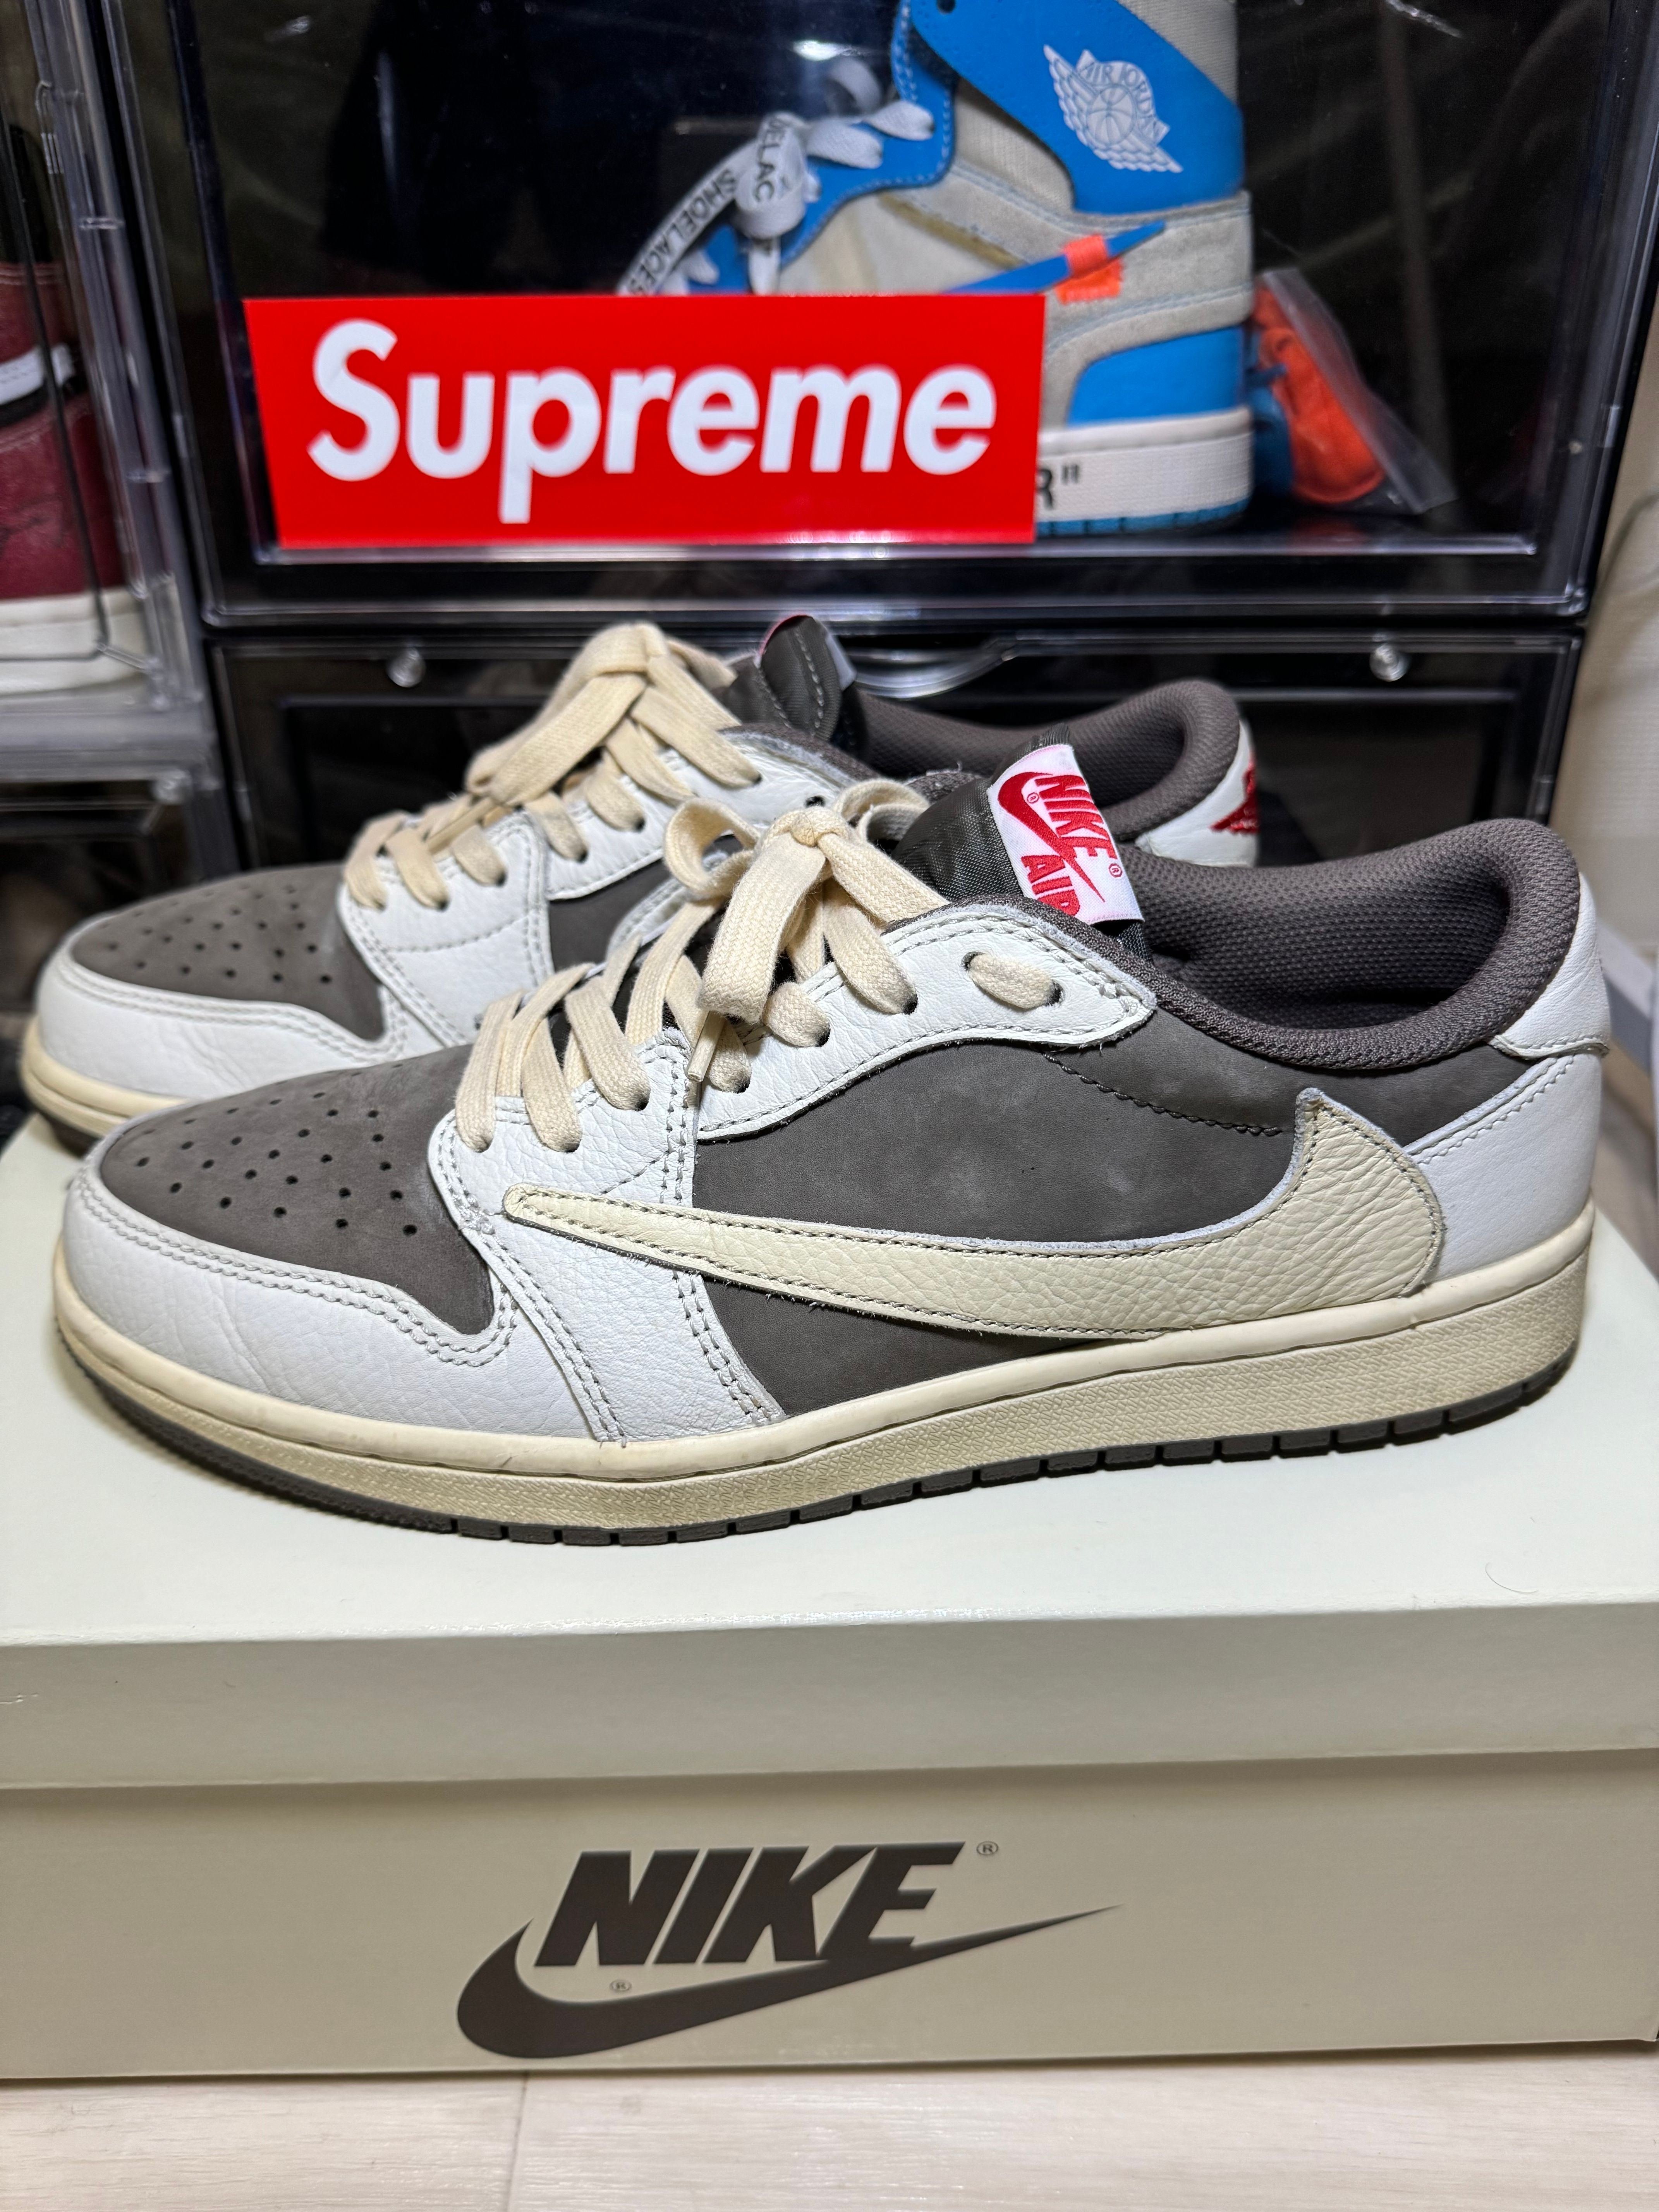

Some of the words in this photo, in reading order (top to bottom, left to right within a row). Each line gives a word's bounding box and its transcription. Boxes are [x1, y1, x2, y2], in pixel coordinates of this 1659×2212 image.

[307, 318, 996, 525] Supreme
[1034, 775, 1118, 860] NIKE
[534, 1841, 966, 1966] NIKE
